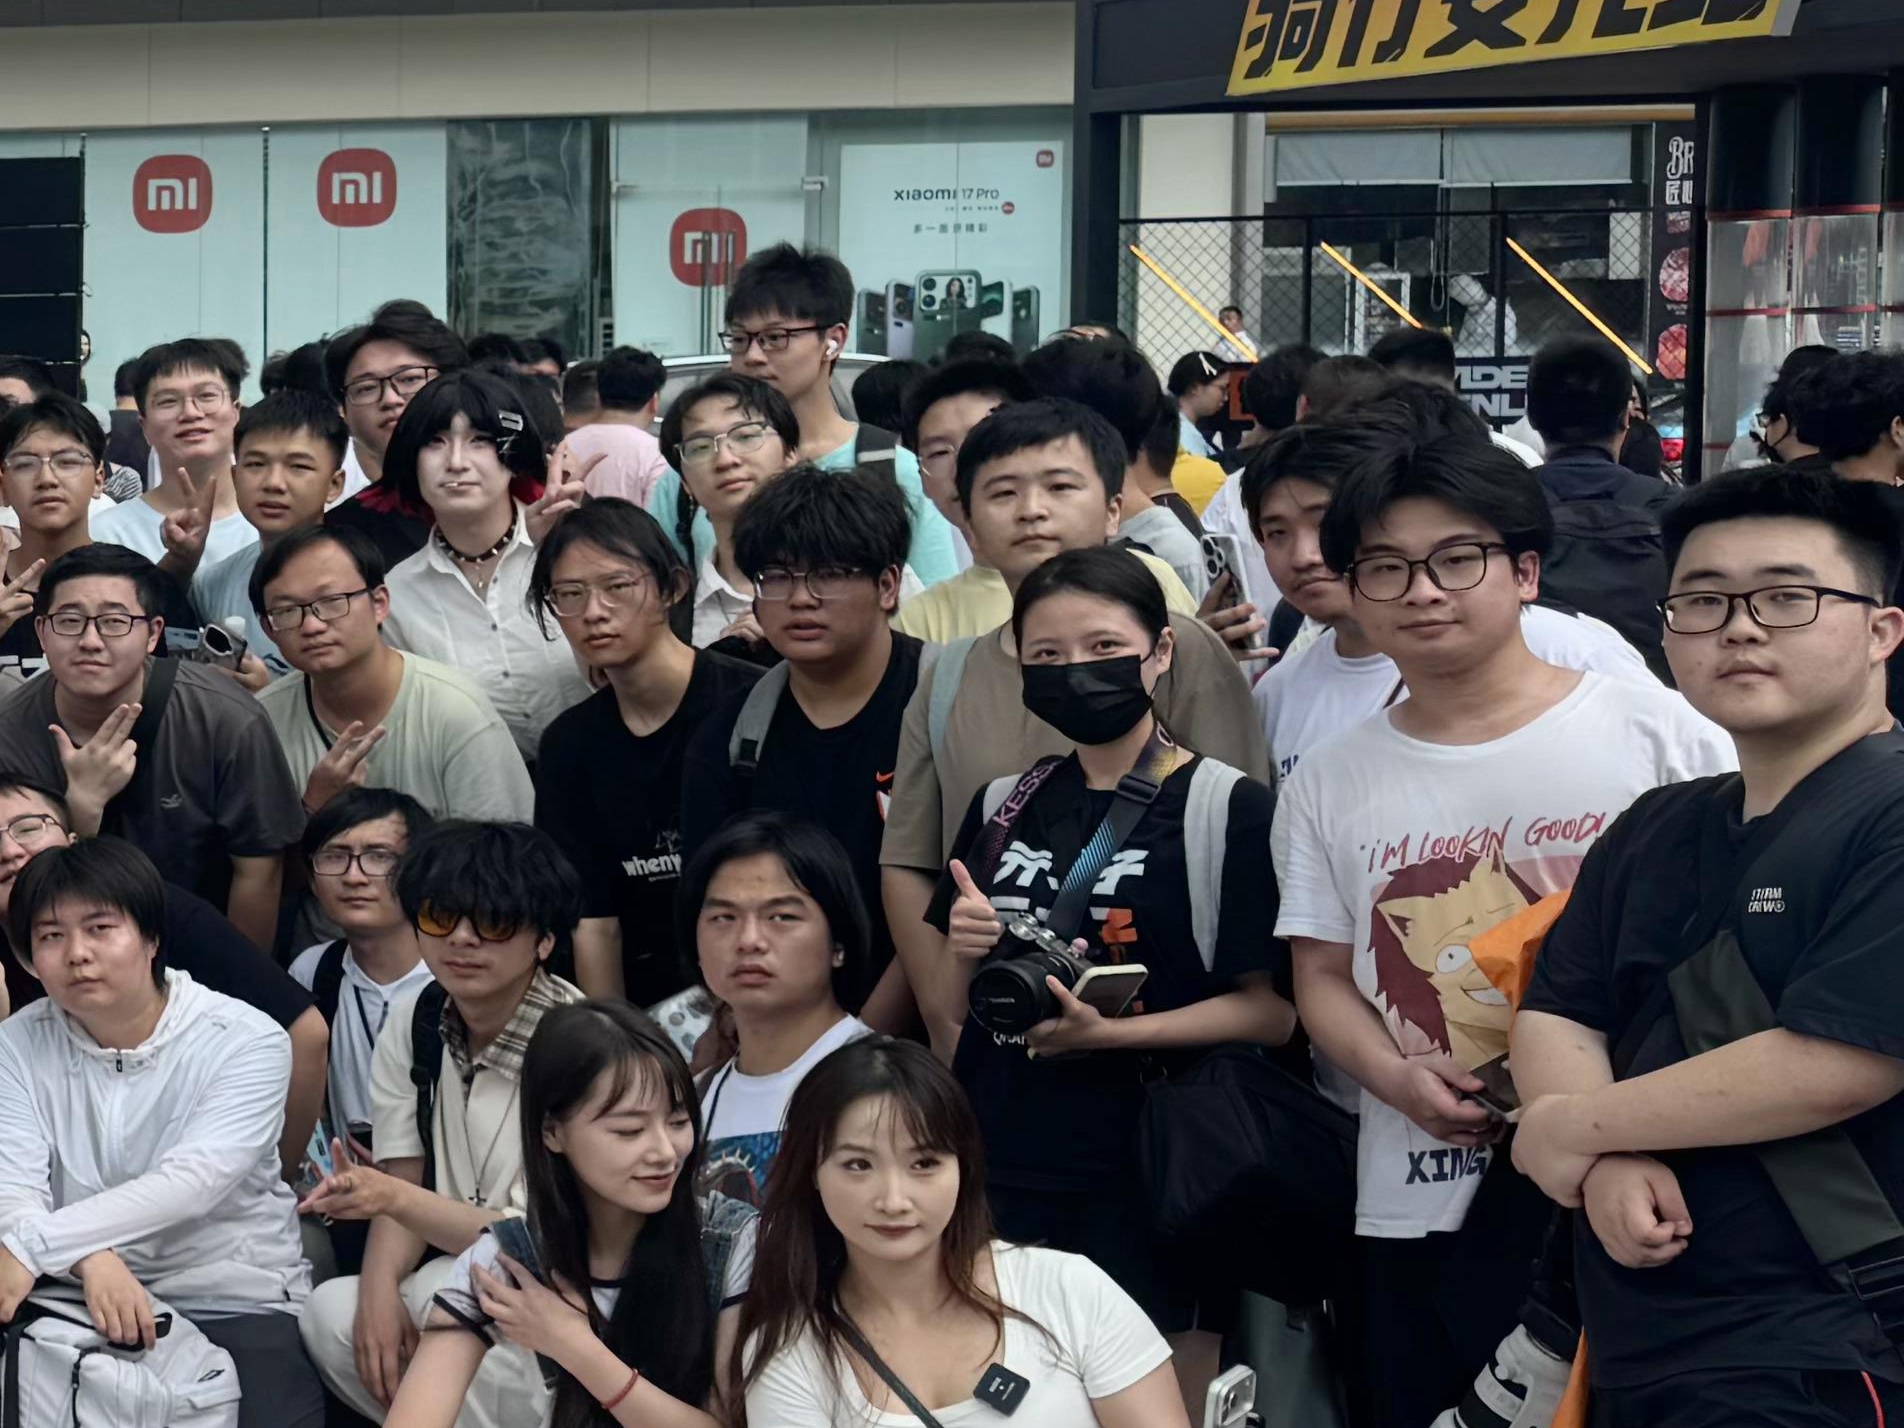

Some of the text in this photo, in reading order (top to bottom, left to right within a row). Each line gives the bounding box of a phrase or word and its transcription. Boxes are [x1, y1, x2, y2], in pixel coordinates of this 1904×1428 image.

[894, 188, 1000, 201] xiaomi 17 Pro
